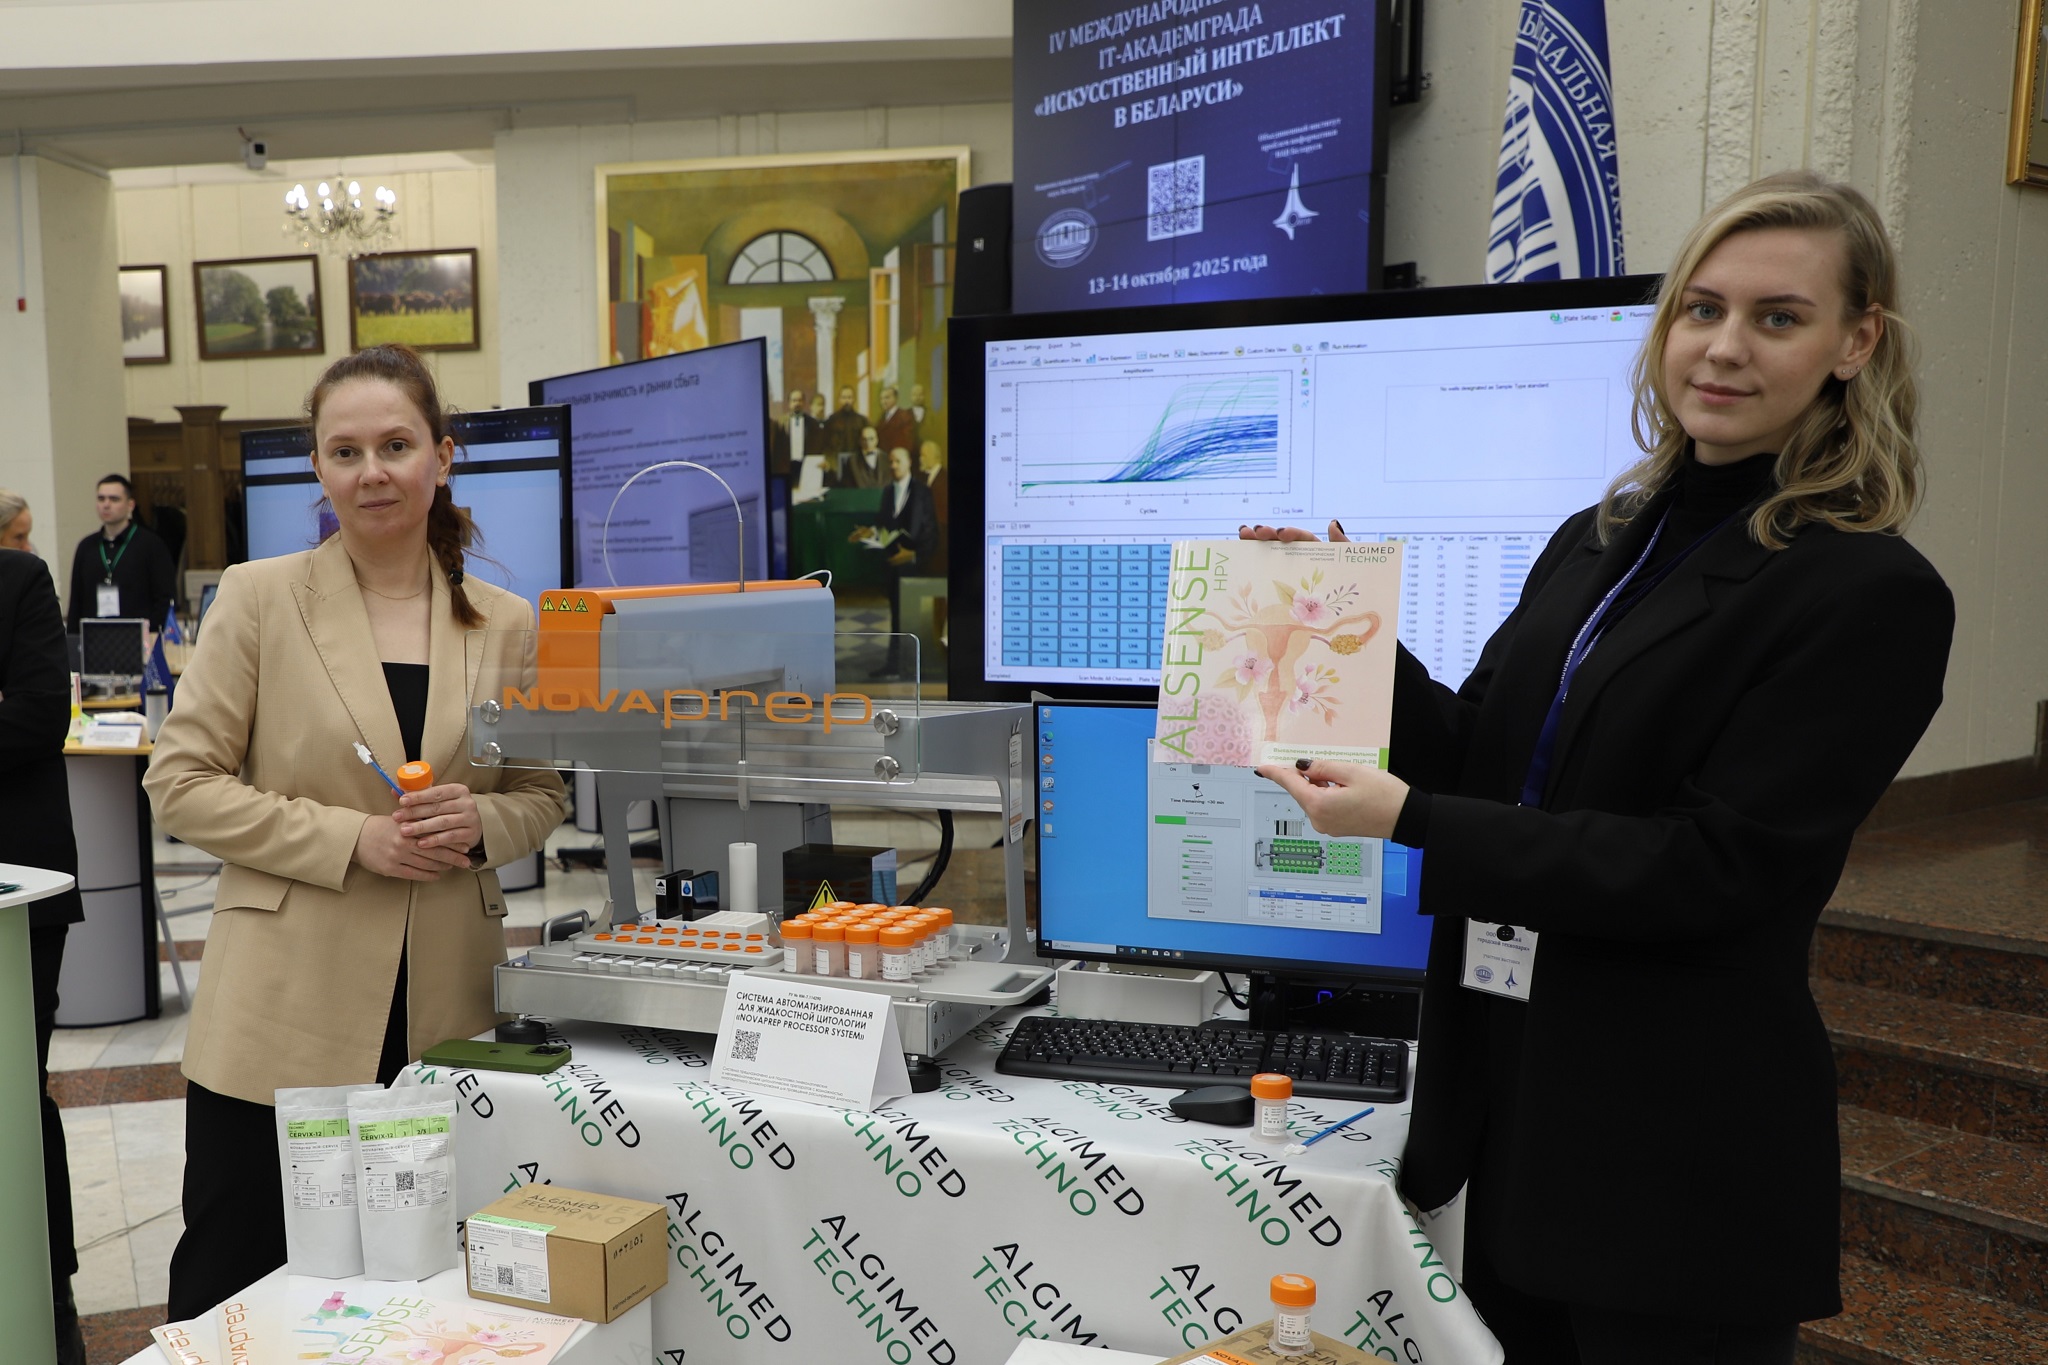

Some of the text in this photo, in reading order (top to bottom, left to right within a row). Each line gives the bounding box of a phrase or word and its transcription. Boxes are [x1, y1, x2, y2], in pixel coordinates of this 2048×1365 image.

[1069, 0, 1237, 48] МЕЖДУНАРОД
[1034, 13, 1346, 117] «ИСКУССТВЕННЫЙ ИНТЕЛЛЕКТ
[1114, 78, 1244, 128] В БЕЛАРУСИ»
[1130, 265, 1190, 287] октября
[1192, 256, 1230, 278] 2025
[1232, 254, 1268, 273] года
[1213, 552, 1230, 591] HPV
[1345, 546, 1395, 554] ALGIMED
[1345, 555, 1387, 563] TECHNO
[1159, 547, 1212, 758] ALSENSE
[502, 686, 873, 734] NOVAprep
[736, 991, 874, 1020] СИСТЕМА АВТОМАТИЗИРОВАННАЯ
[736, 1014, 864, 1040] «NOVAPREP PROCESSOR SYSTEM»
[738, 1002, 867, 1030] ДЛЯ ЖИДКОСТНОЙ ЦИТОЛОГИИ
[616, 1027, 670, 1065] TECHNO
[650, 1027, 708, 1068] ALGIMED
[539, 1070, 602, 1147] CHNO
[564, 1062, 641, 1148] ALGIMED
[673, 1080, 754, 1170] TECHNO
[361, 1133, 393, 1141] CERVIX-12
[871, 1106, 966, 1198] LGIMED
[992, 1118, 1097, 1216] TECHNO
[1022, 1116, 1144, 1216] ALGIMED
[521, 1200, 581, 1214] TECHNO
[528, 1194, 600, 1210] ALGIMED
[1174, 1140, 1291, 1246] TECHNO
[1203, 1138, 1342, 1247] ALGIMED
[666, 1192, 792, 1342] ALGIMED
[668, 1214, 750, 1340] ECHNO
[802, 1227, 912, 1365] TECHNO
[820, 1215, 956, 1365] ALGIMED
[972, 1256, 1050, 1340] TECH
[992, 1243, 1109, 1349] ALGIM
[416, 1302, 436, 1319] HPV
